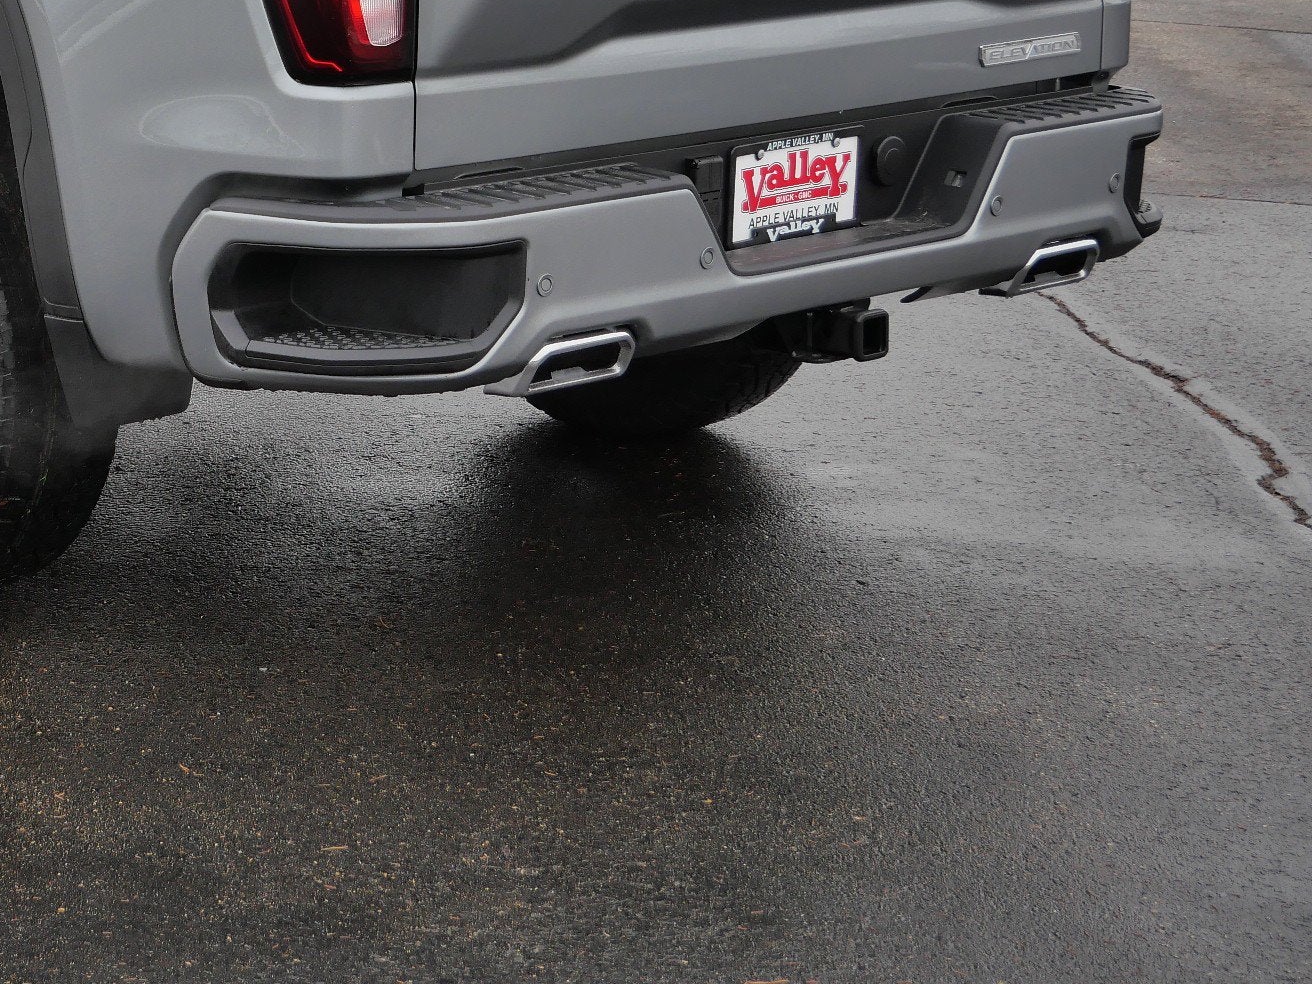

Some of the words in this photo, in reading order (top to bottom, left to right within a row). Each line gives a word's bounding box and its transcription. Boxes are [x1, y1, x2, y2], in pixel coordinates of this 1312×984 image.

[767, 139, 791, 151] APPLE
[822, 132, 834, 142] MN
[741, 149, 851, 213] Valley
[775, 192, 795, 204] BUICK
[799, 190, 812, 200] GMC
[749, 213, 780, 229] APPLE
[824, 202, 839, 214] MN
[767, 218, 825, 242] Valley
